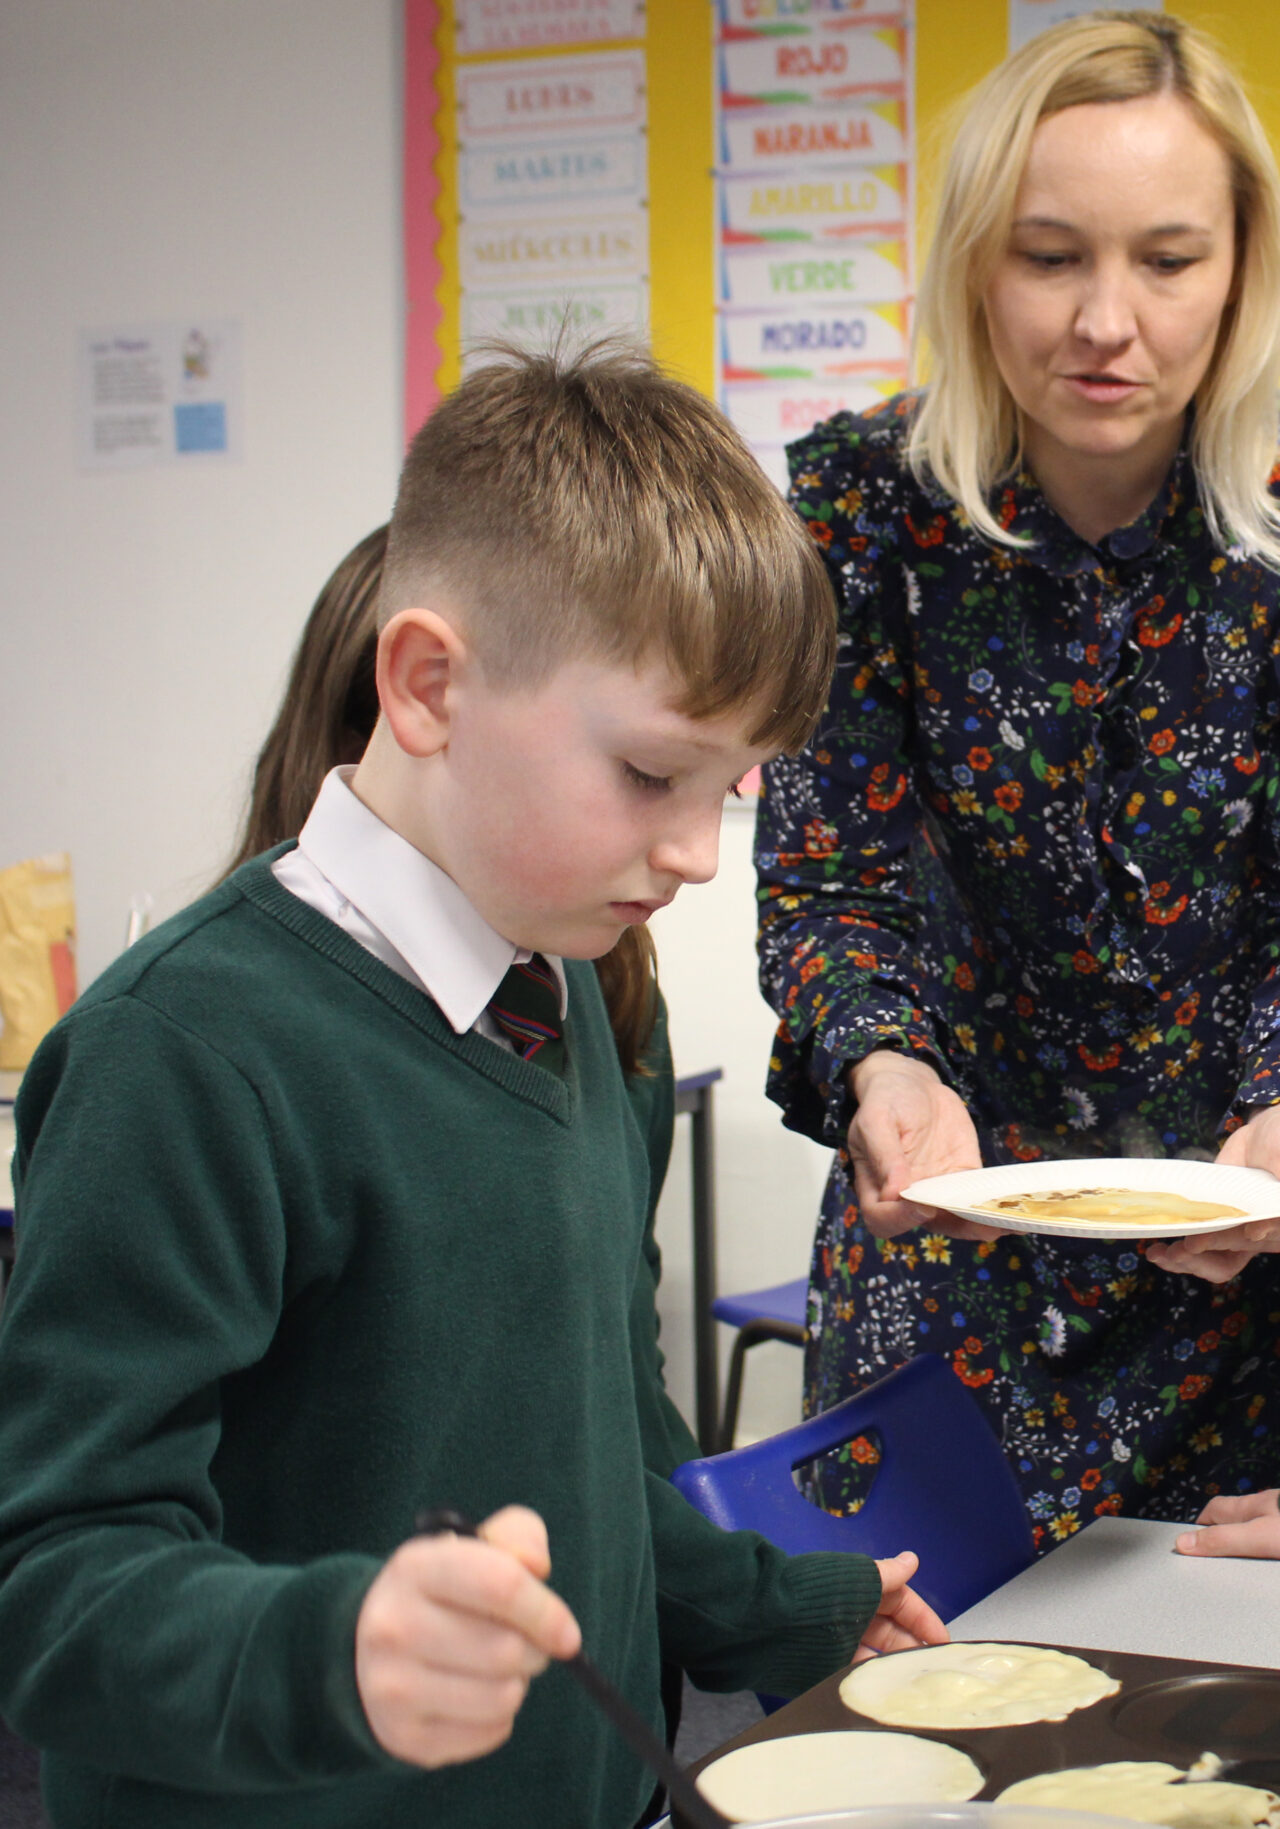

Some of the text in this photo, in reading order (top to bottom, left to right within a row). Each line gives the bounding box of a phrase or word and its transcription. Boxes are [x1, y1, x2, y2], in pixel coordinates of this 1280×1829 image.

[777, 43, 848, 77] ROJO
[753, 119, 874, 156] NARANJA
[748, 181, 878, 216] AMARILLO
[768, 259, 857, 293] VERDE
[762, 318, 867, 353] MORADO
